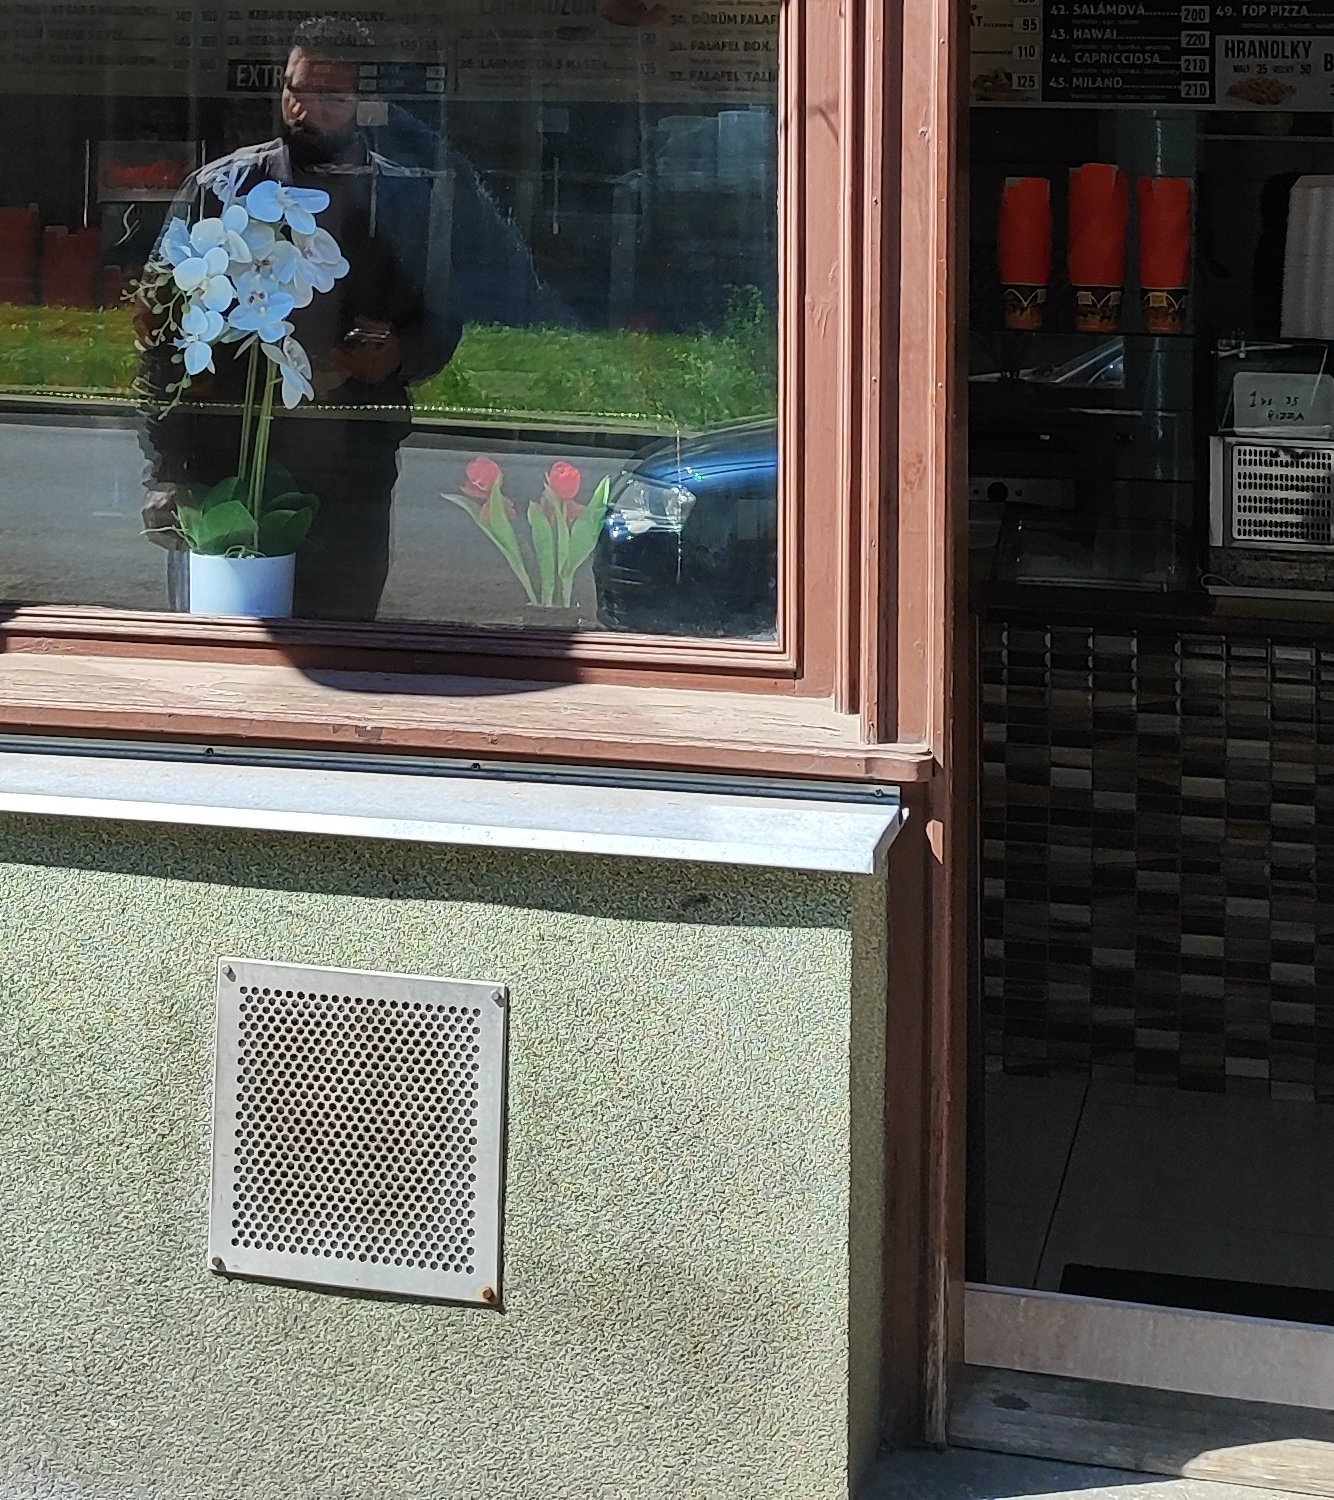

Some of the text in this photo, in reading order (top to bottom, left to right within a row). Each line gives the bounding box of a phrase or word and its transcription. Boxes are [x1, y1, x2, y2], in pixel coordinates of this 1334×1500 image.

[1073, 2, 1206, 20] SALÁMOVÁ 200
[1241, 6, 1266, 16] TOP
[1270, 6, 1309, 16] PIZZA
[1073, 29, 1205, 46] HAWAI 220
[1224, 40, 1312, 58] HRANOLKY
[1074, 53, 1160, 63] CAPRICCIOSA
[1184, 59, 1206, 71] 210
[1072, 78, 1206, 95] MILANO 210
[1268, 409, 1305, 421] PIZZA
